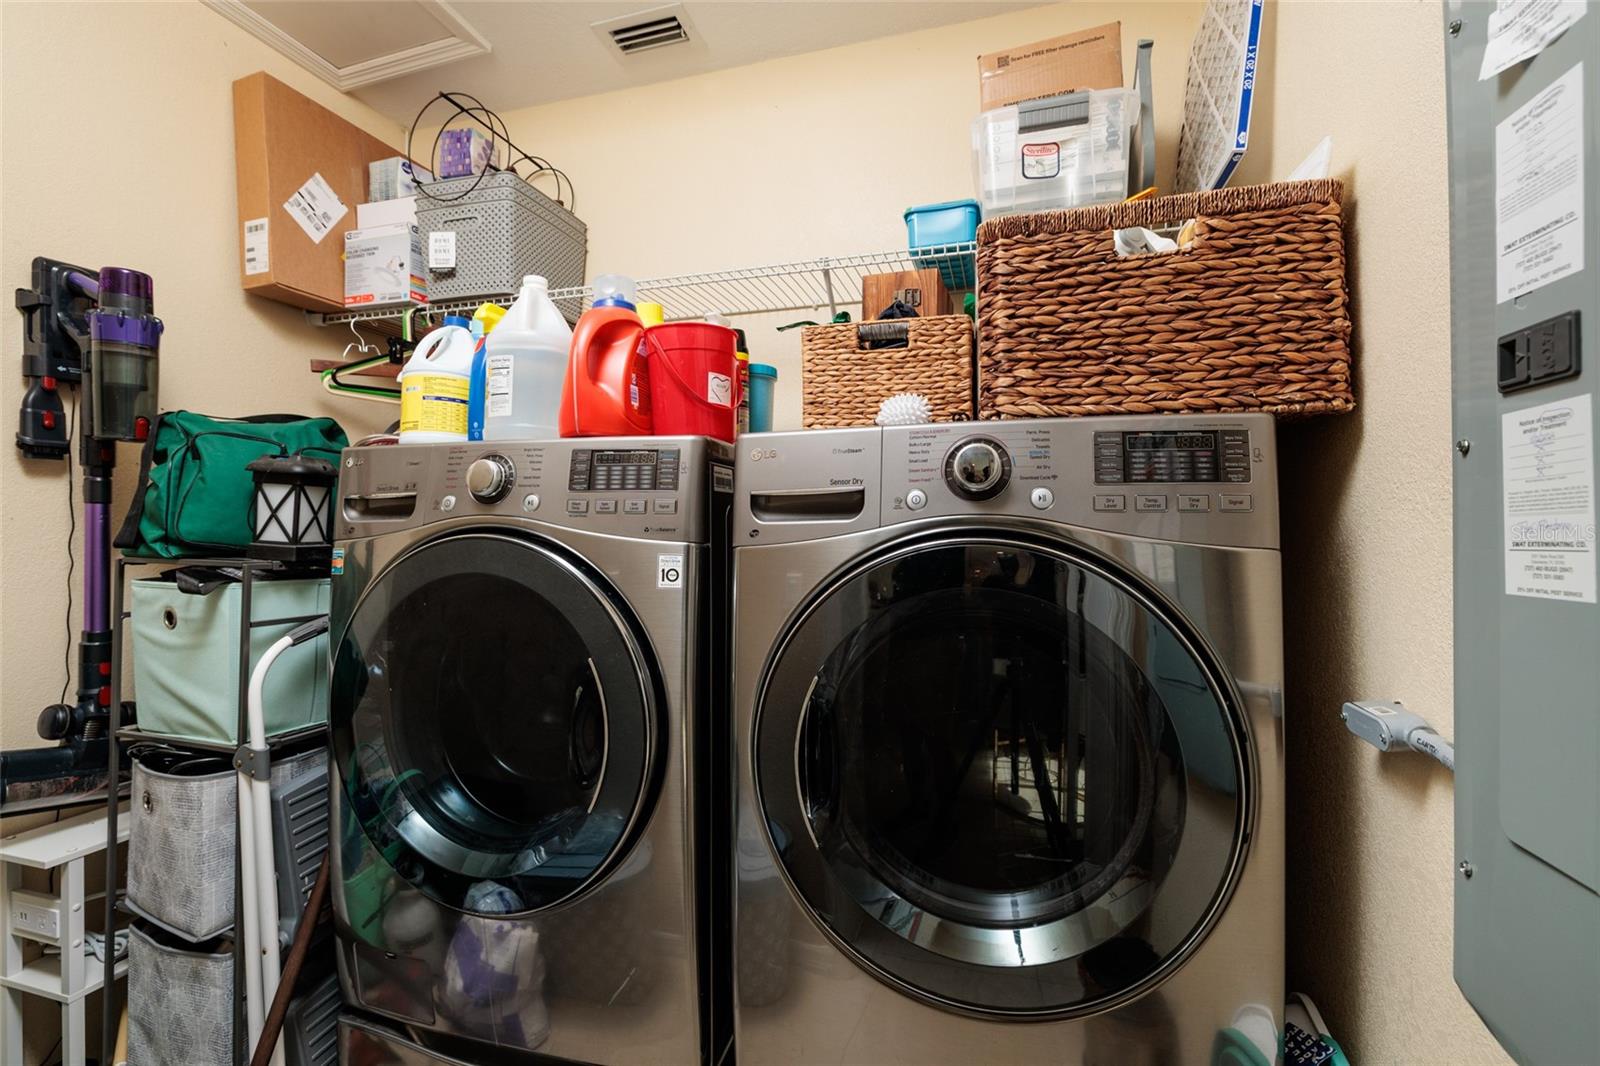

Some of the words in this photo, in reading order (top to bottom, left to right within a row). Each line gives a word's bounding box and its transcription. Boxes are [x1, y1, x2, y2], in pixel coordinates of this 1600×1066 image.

[1011, 54, 1023, 62] Scan
[1032, 49, 1045, 57] FREE
[1046, 46, 1058, 54] filter
[1059, 42, 1077, 52] change
[1078, 35, 1105, 47] reminders
[1246, 60, 1256, 71] 20
[1243, 79, 1253, 90] 20
[829, 478, 851, 487] Sensor
[852, 477, 864, 486] Dry
[661, 568, 680, 582] 10
